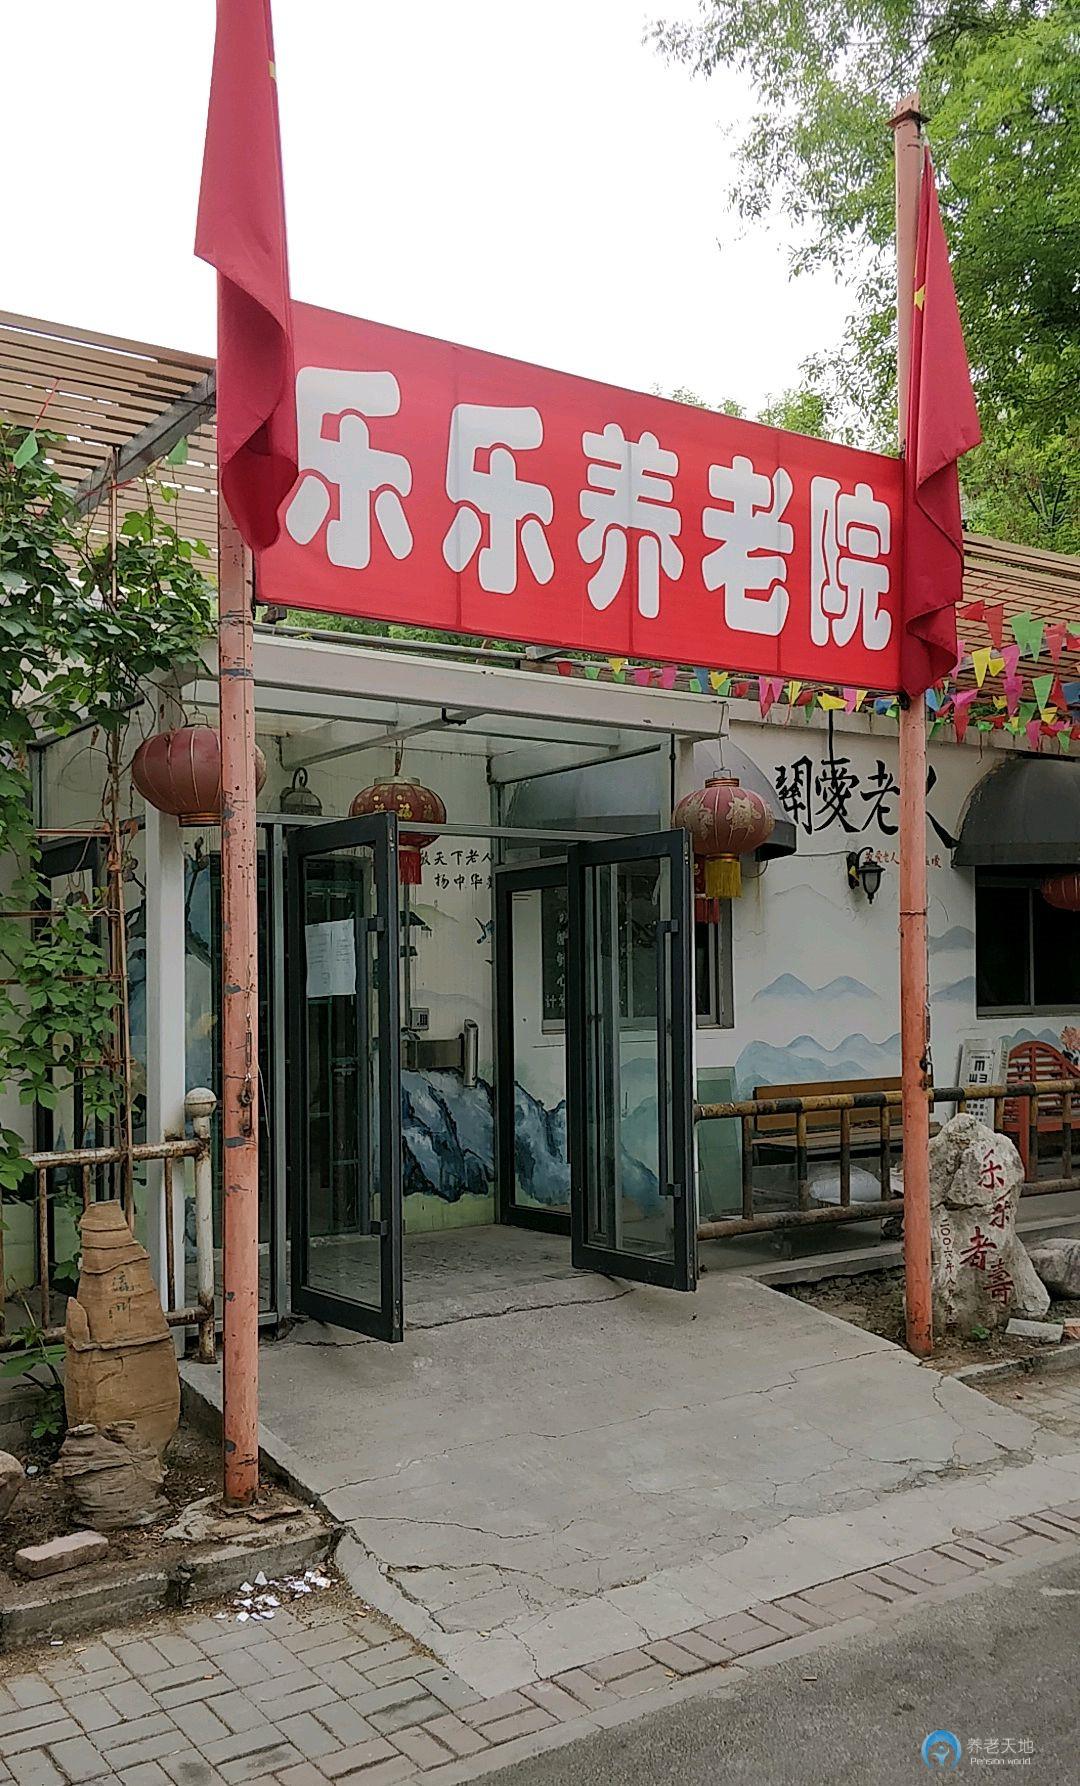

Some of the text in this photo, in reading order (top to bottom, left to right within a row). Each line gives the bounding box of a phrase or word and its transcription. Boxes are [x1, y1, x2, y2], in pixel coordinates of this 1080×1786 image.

[284, 365, 893, 651] 乐乐养老院
